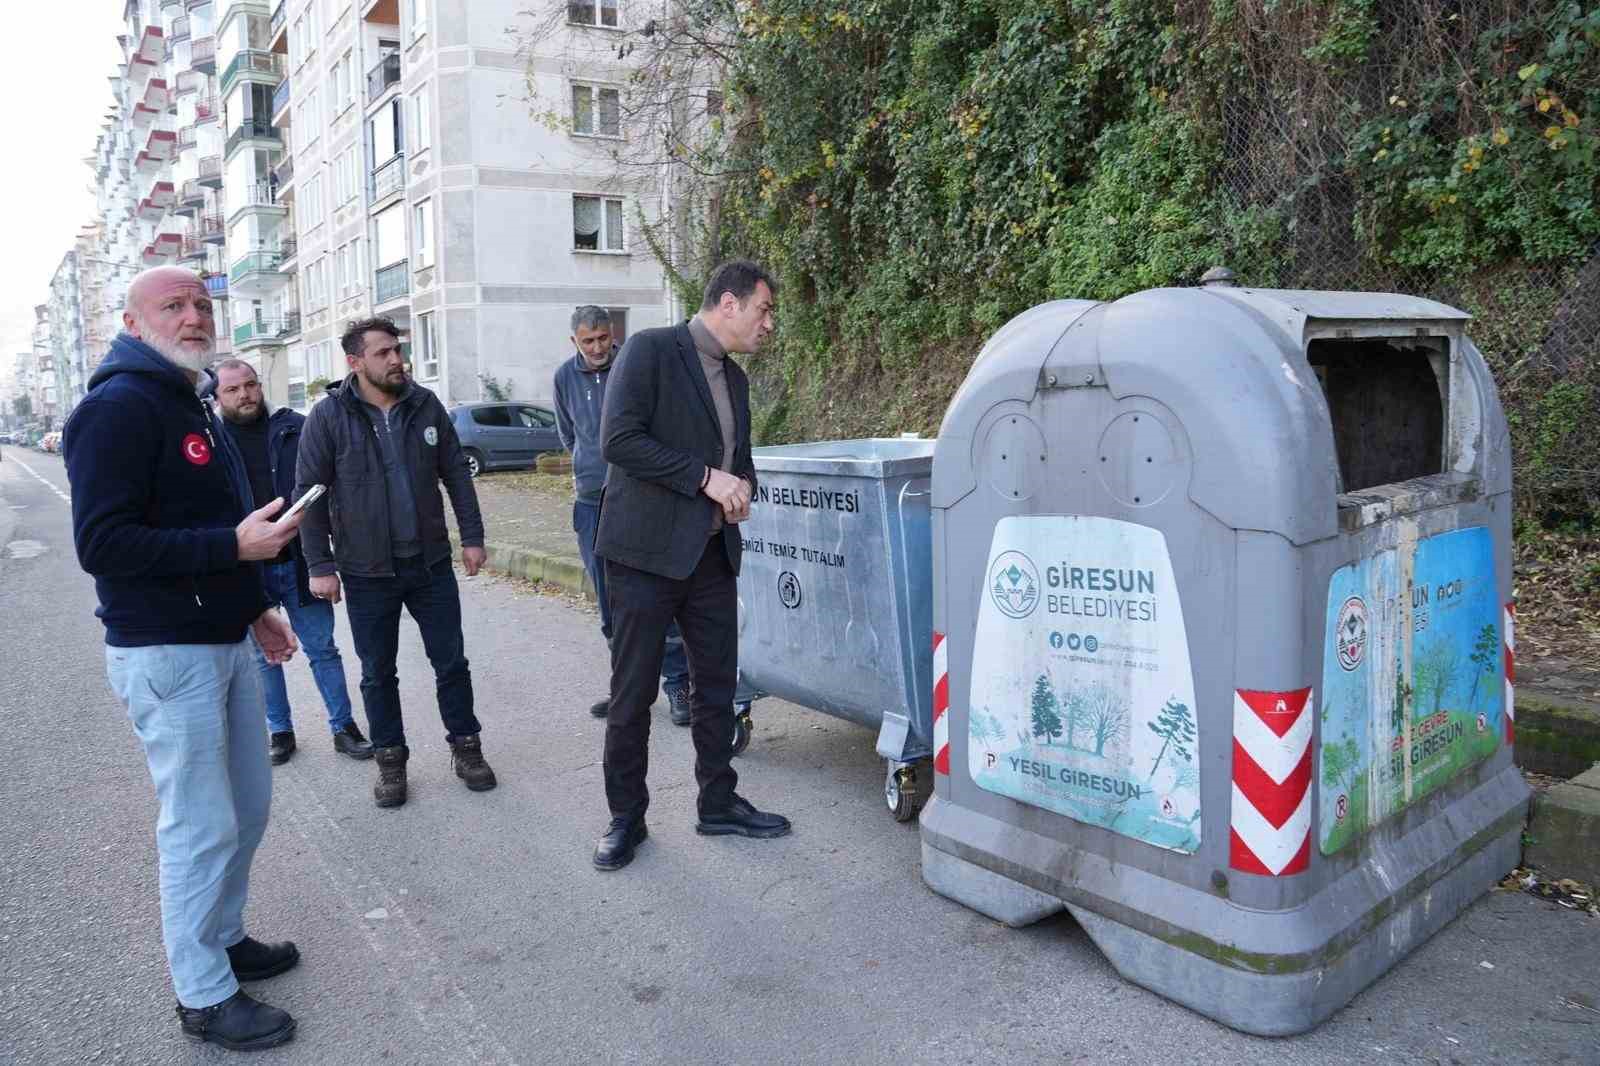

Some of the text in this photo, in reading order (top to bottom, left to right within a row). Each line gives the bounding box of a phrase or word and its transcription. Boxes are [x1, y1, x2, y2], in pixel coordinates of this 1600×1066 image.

[772, 486, 859, 513] BELEDİYESİ
[767, 542, 798, 560] TEMİZ
[801, 546, 845, 569] TUTALIM
[1047, 561, 1155, 594] GİRESUN
[1047, 594, 1157, 622] BELEDİYESİ
[1060, 767, 1141, 800] GİRESUN
